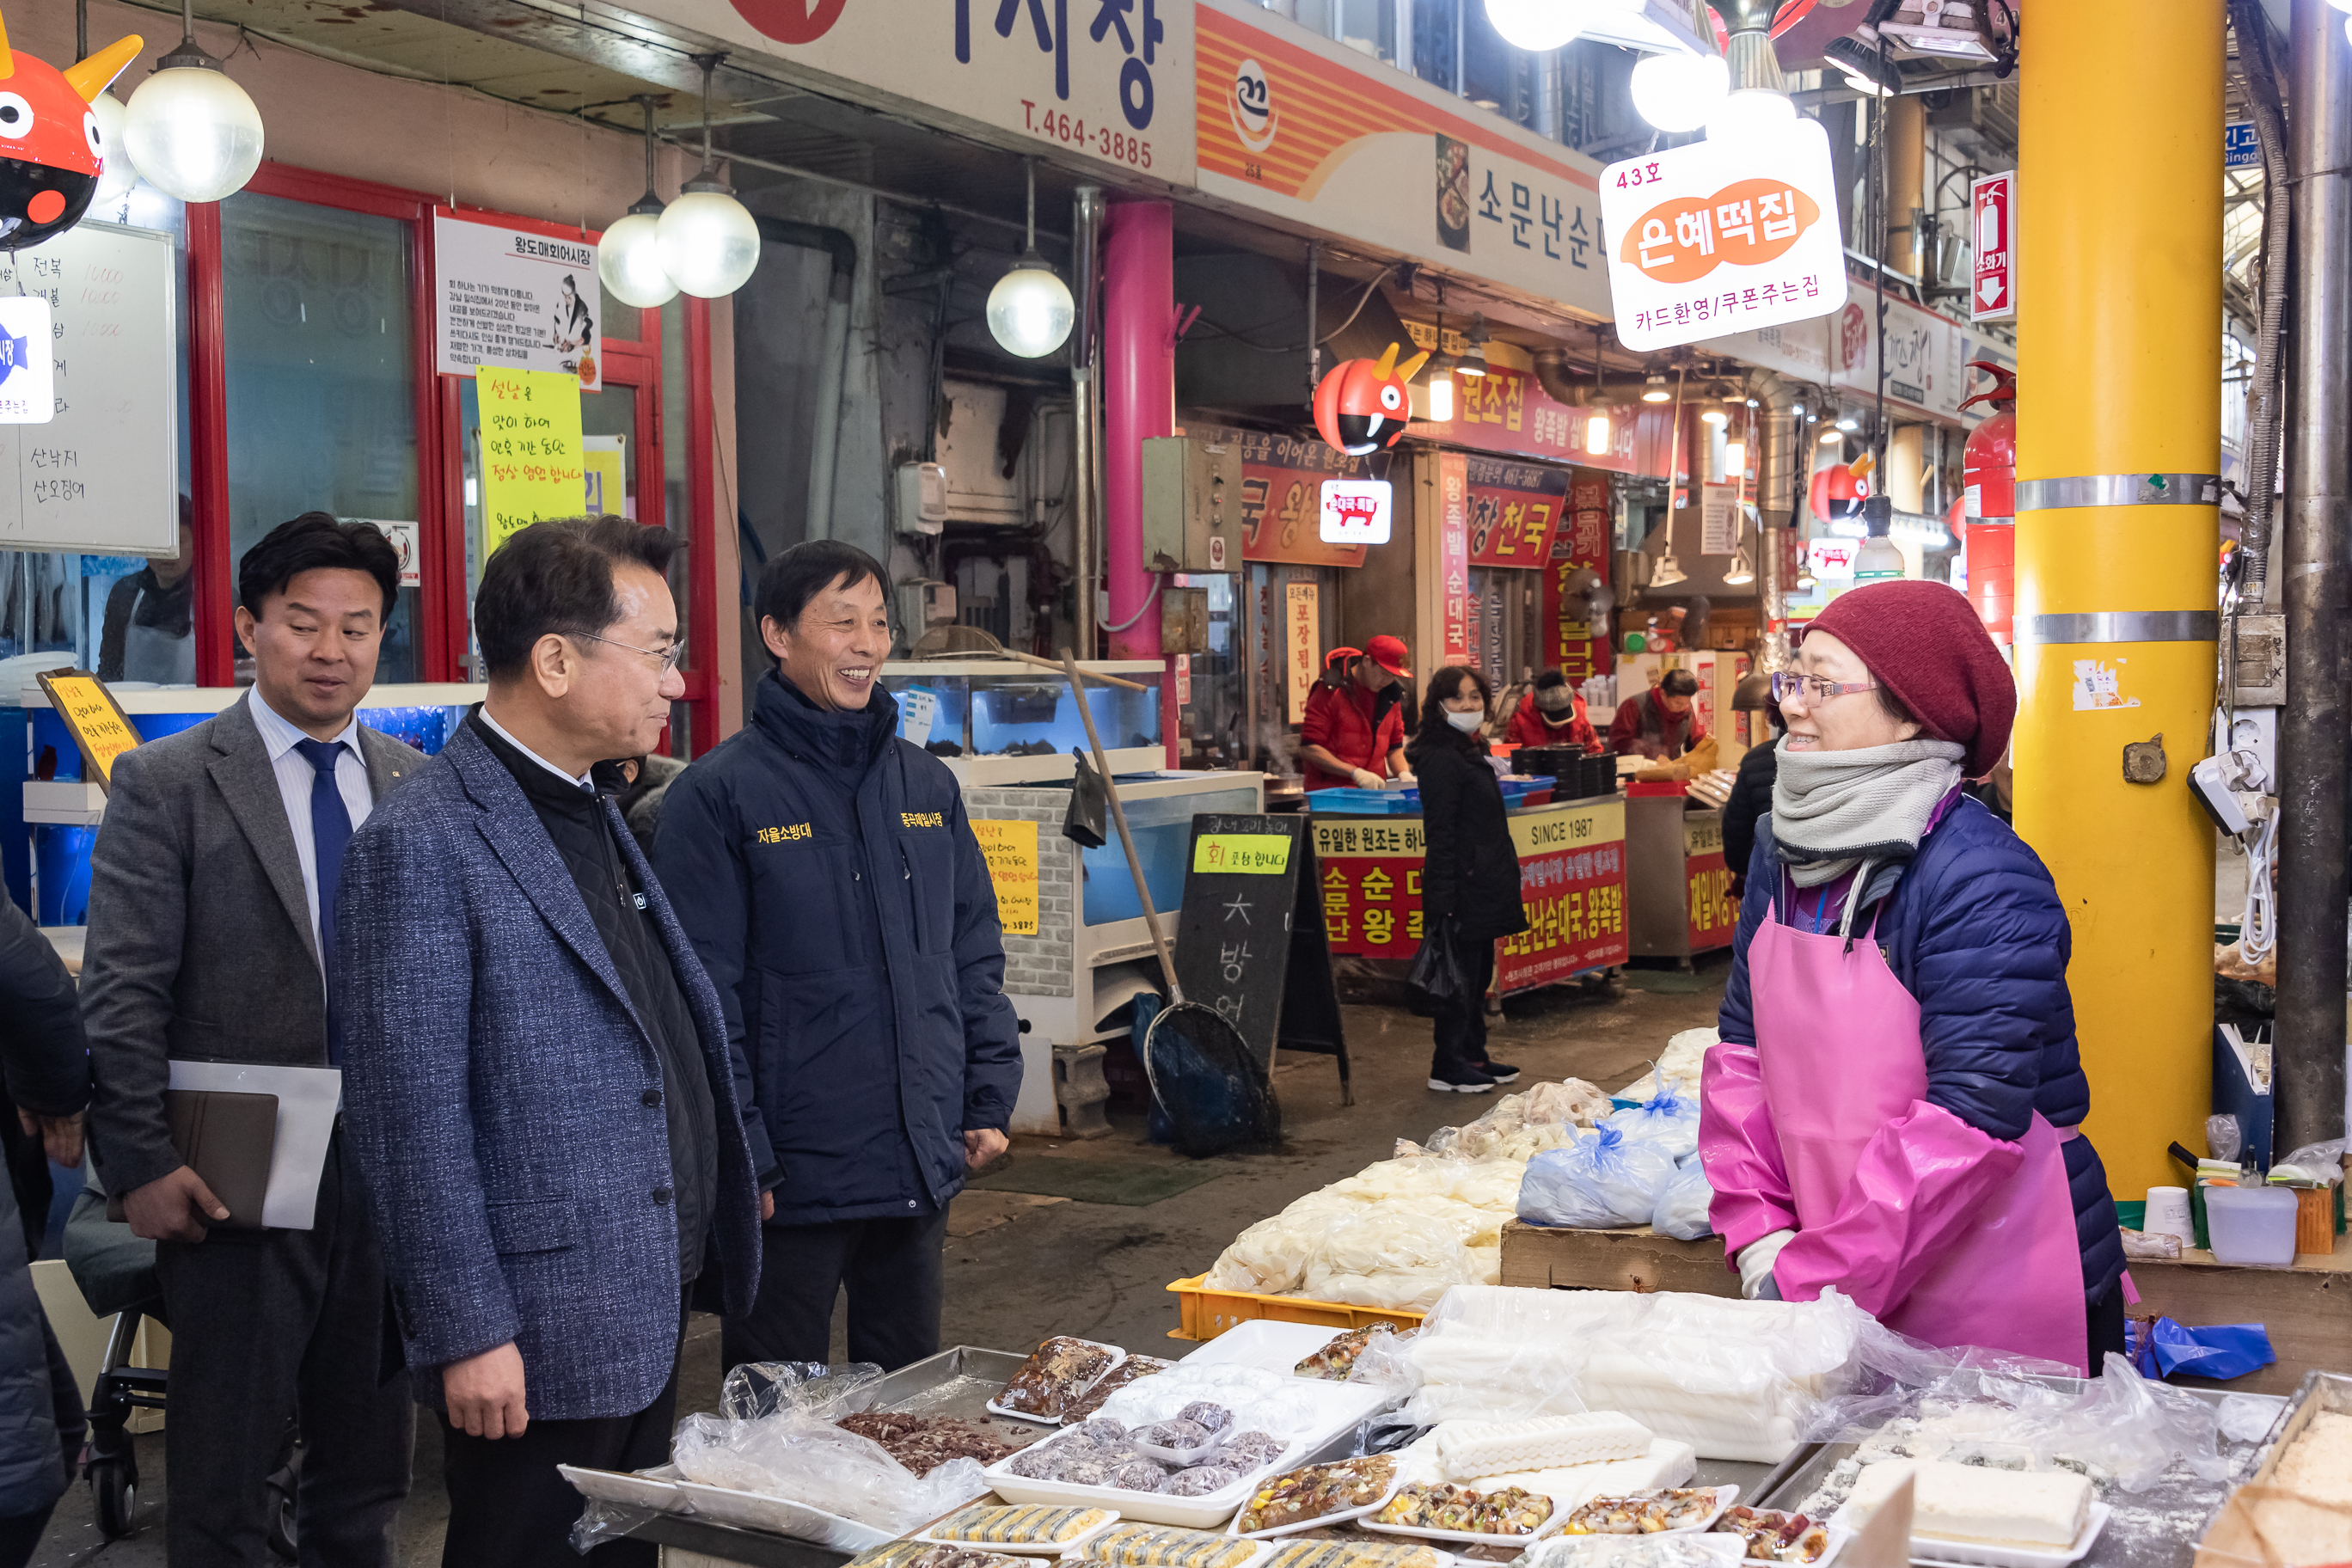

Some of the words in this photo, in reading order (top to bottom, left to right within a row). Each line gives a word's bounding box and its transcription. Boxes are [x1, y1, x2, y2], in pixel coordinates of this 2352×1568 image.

[1020, 99, 1153, 168] T.464-3885
[1617, 162, 1663, 188] 43호
[1638, 189, 1798, 269] 은혜떡집
[516, 236, 591, 266] 왕도매회어시장
[1976, 251, 2006, 273] 소화기
[34, 257, 61, 279] 전복
[457, 280, 475, 292] 하나는
[450, 291, 462, 303] 강남
[495, 298, 509, 309] 20년
[1636, 274, 1819, 332] 카드환영/쿠폰주는집
[31, 448, 78, 469] 산낙지
[517, 440, 536, 456] 기간
[541, 438, 566, 456] 동안
[491, 464, 518, 482] 정상
[549, 464, 583, 484] 합니다
[34, 479, 85, 503] 산오징어
[900, 812, 943, 828] 중곡제일시장
[1531, 822, 1566, 845] SINCE
[1569, 818, 1593, 839] 1987
[756, 823, 812, 844] 자율소방대
[1362, 827, 1400, 852] 원조는
[1208, 841, 1225, 867] 회
[1231, 851, 1251, 867] 포장
[1254, 851, 1285, 867] 합니다
